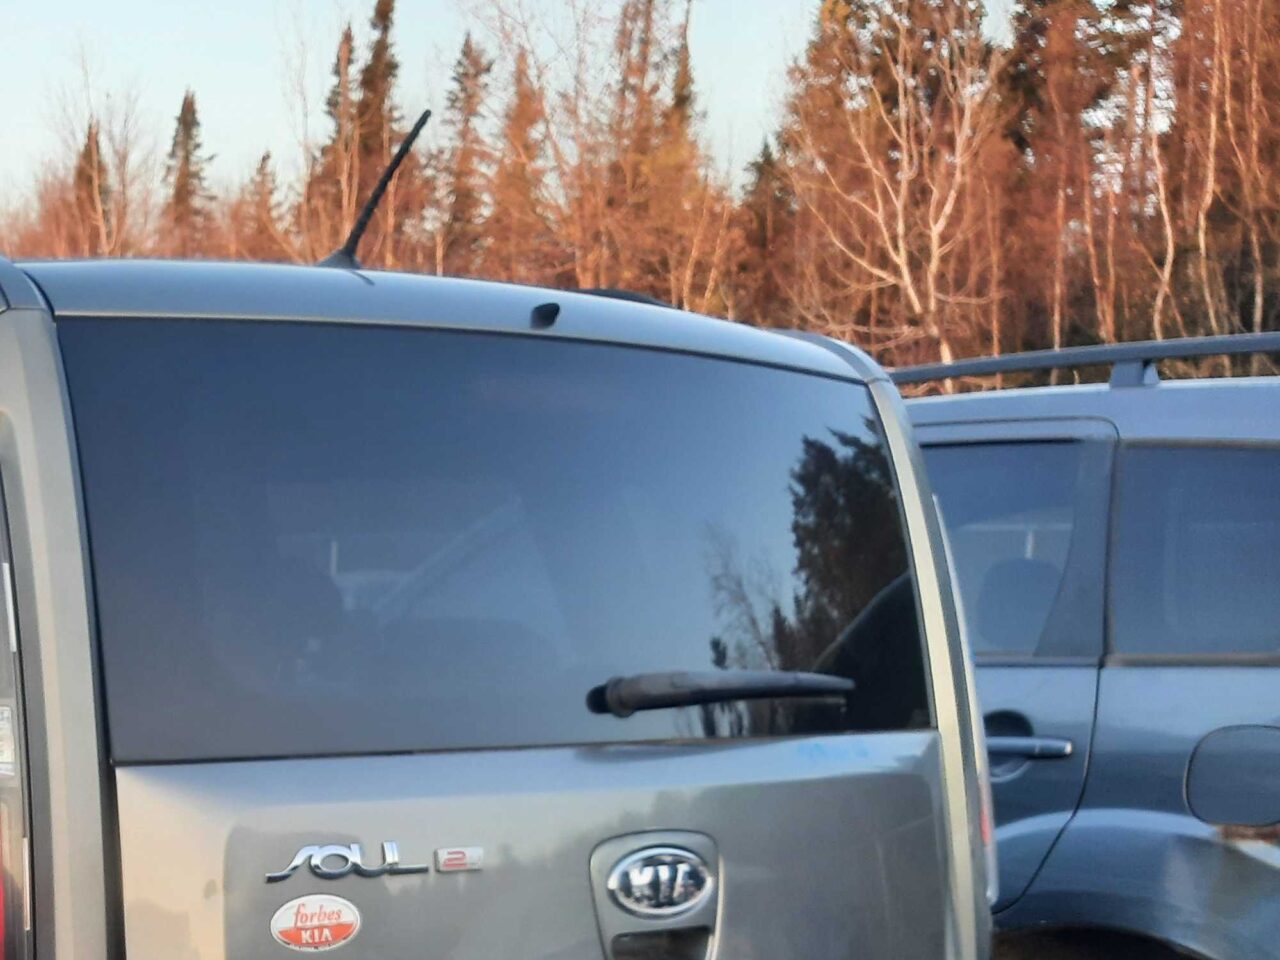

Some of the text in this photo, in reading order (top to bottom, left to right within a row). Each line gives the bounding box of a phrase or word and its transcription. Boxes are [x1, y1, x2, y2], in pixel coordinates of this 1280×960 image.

[621, 858, 704, 904] KIA
[293, 902, 342, 928] forbes
[300, 926, 333, 943] KIA
